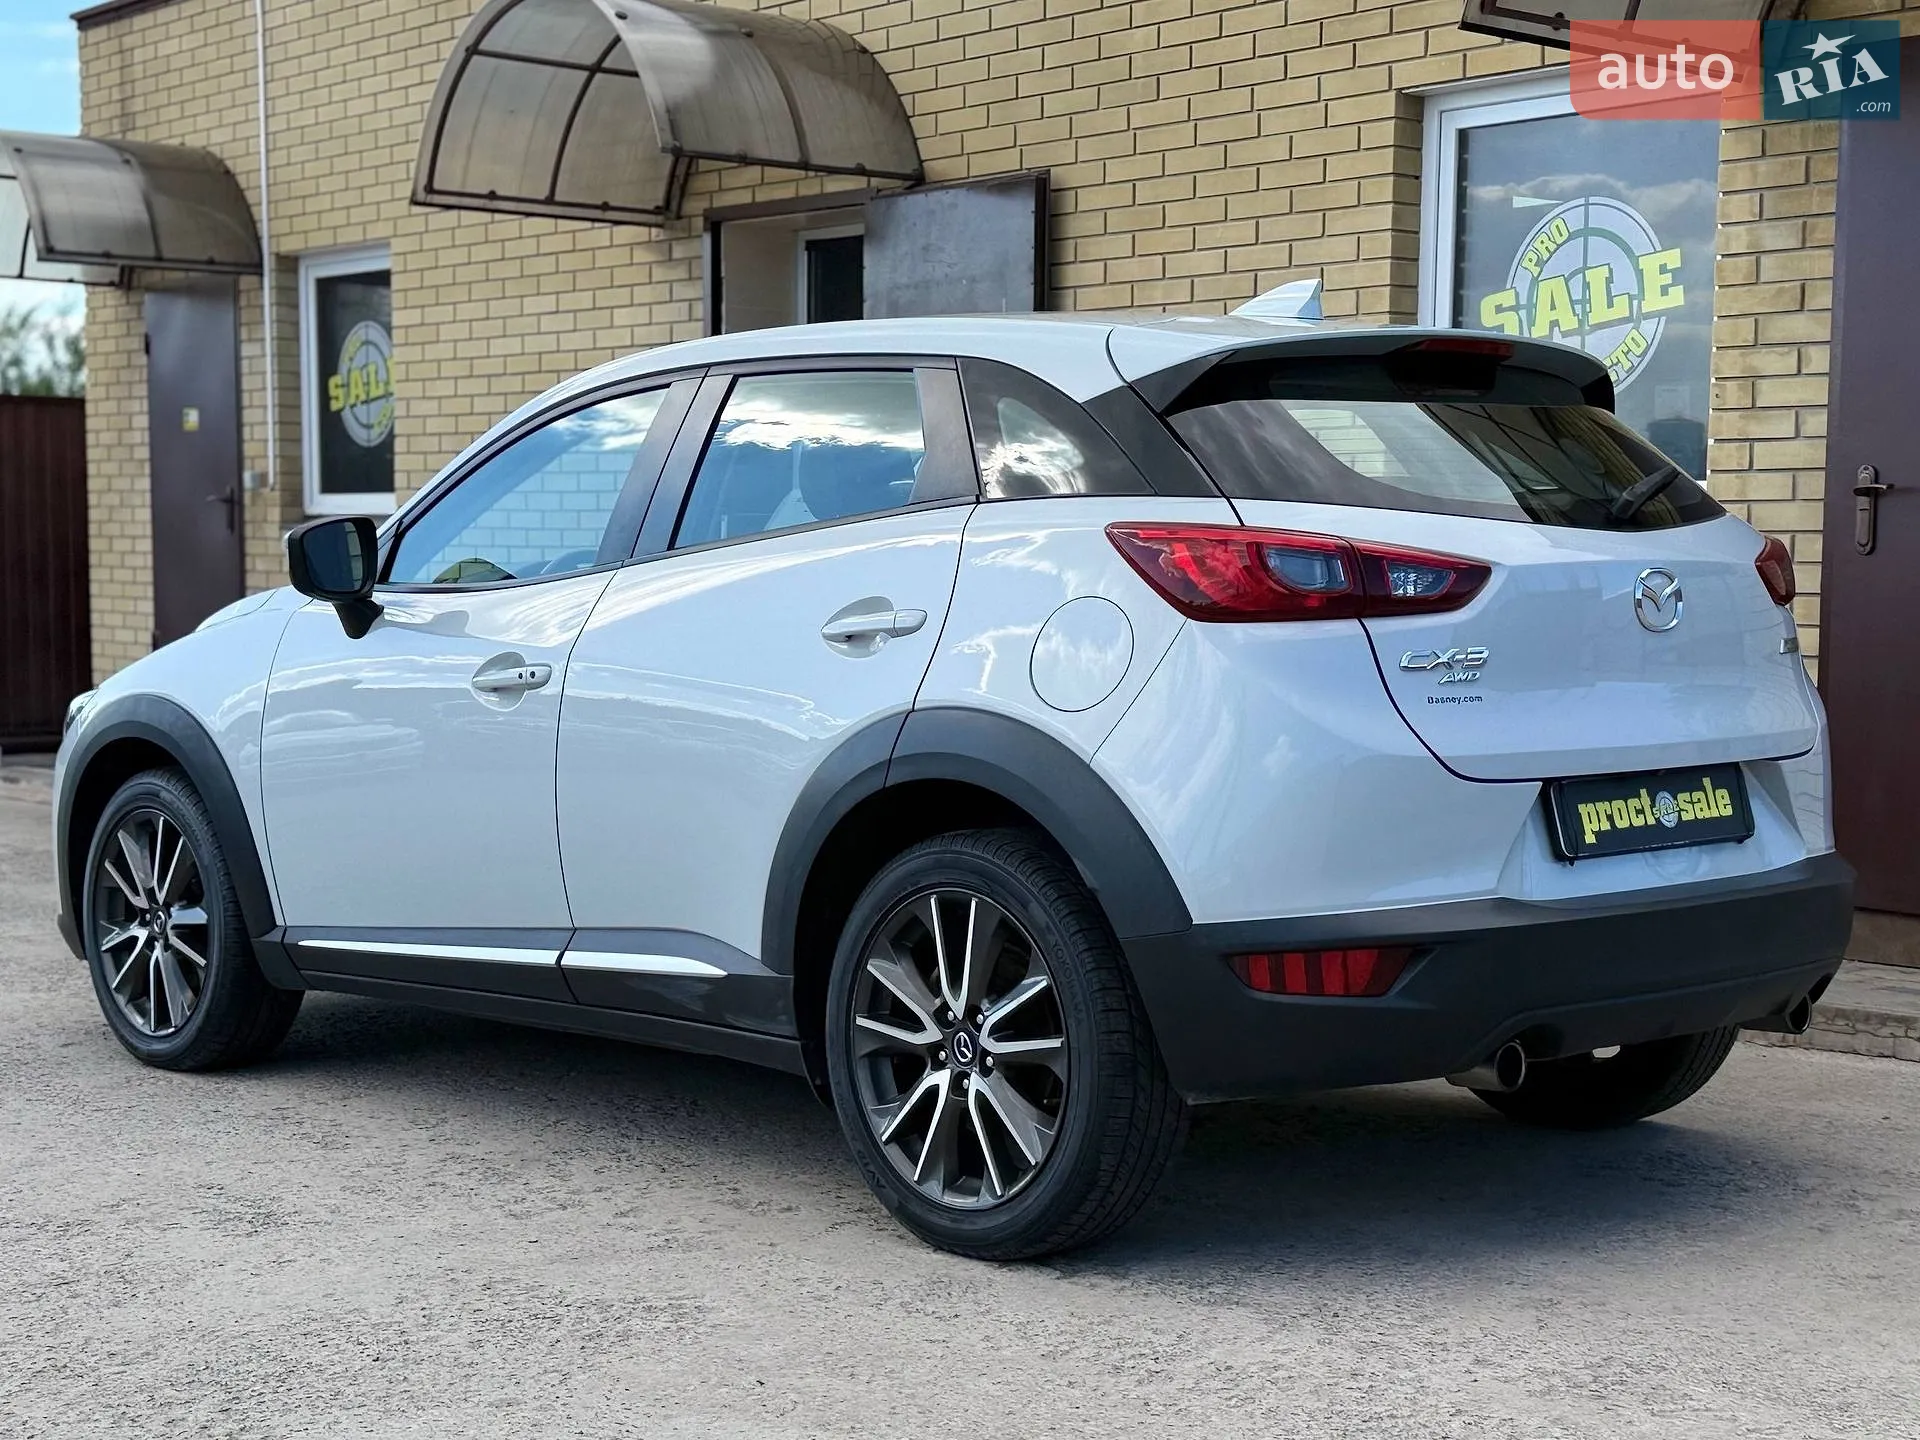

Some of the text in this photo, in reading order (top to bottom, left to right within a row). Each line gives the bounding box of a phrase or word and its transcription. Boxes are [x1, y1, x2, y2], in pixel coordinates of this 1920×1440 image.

[1521, 216, 1570, 278] PRO
[1480, 248, 1685, 338] SALE
[1399, 646, 1490, 671] CX-3
[1438, 671, 1481, 685] AWD
